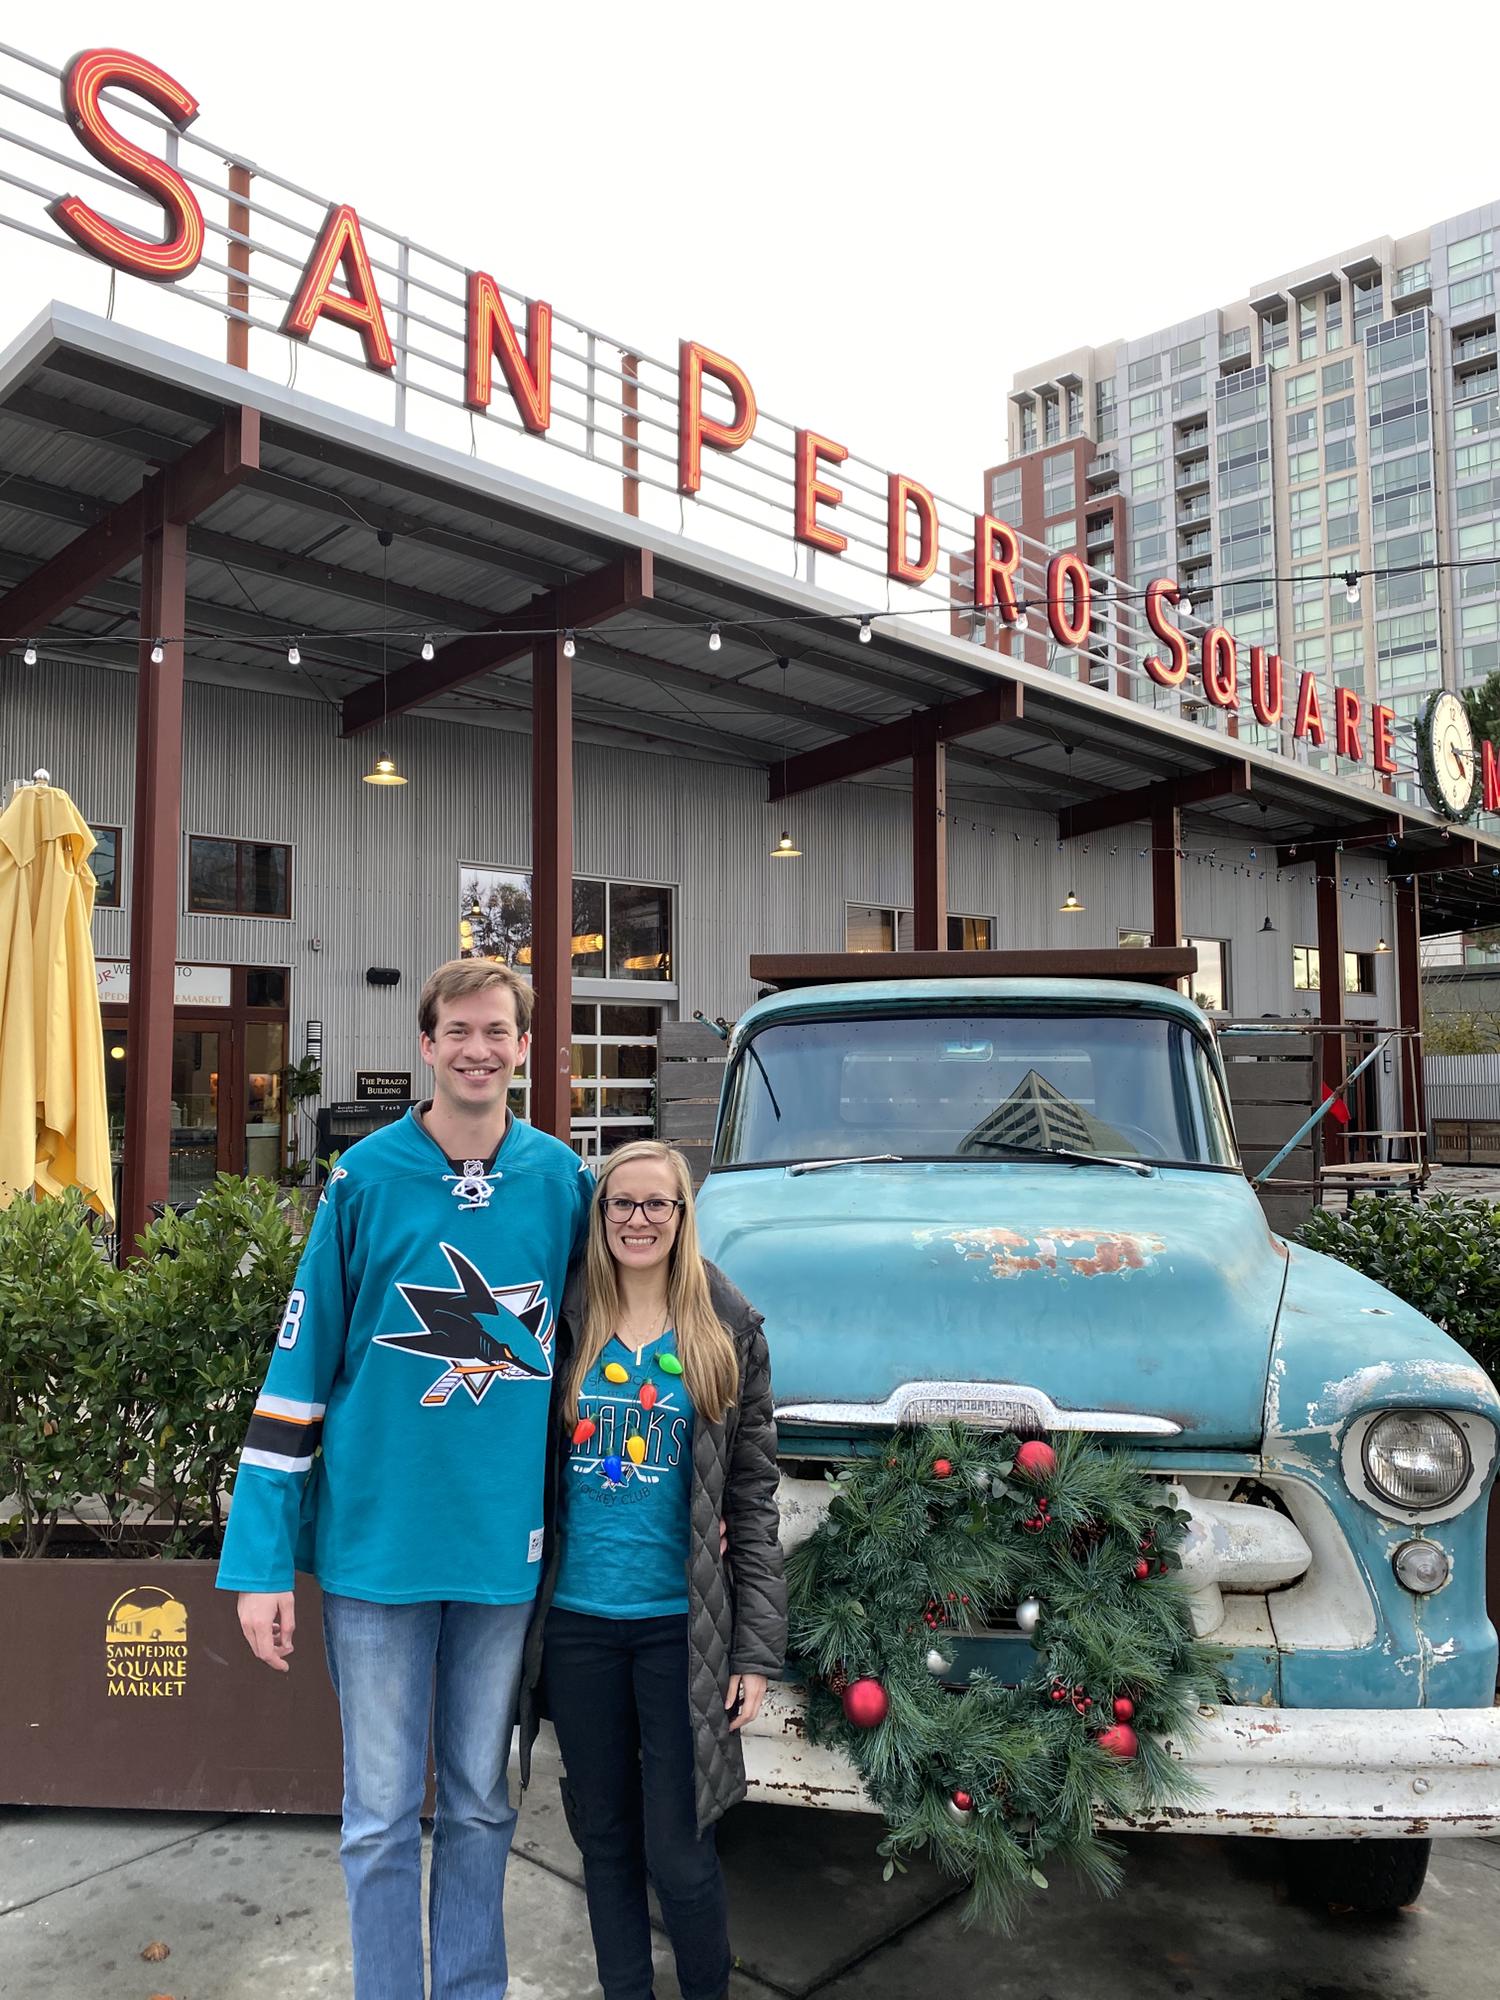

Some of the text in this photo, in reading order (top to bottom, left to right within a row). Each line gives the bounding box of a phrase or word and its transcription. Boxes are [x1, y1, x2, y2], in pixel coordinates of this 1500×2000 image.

[44, 48, 553, 439] SAN
[678, 337, 1092, 647] PEDRO
[1143, 577, 1397, 774] SQUARE
[176, 966, 193, 978] TO
[361, 1077, 408, 1085] THE PERAZZO
[367, 1086, 401, 1095] BUILDING
[569, 1402, 687, 1466] HARKS
[621, 1486, 651, 1505] CLUB
[106, 1659, 187, 1681] SQUARE
[107, 1680, 186, 1697] MARKET
